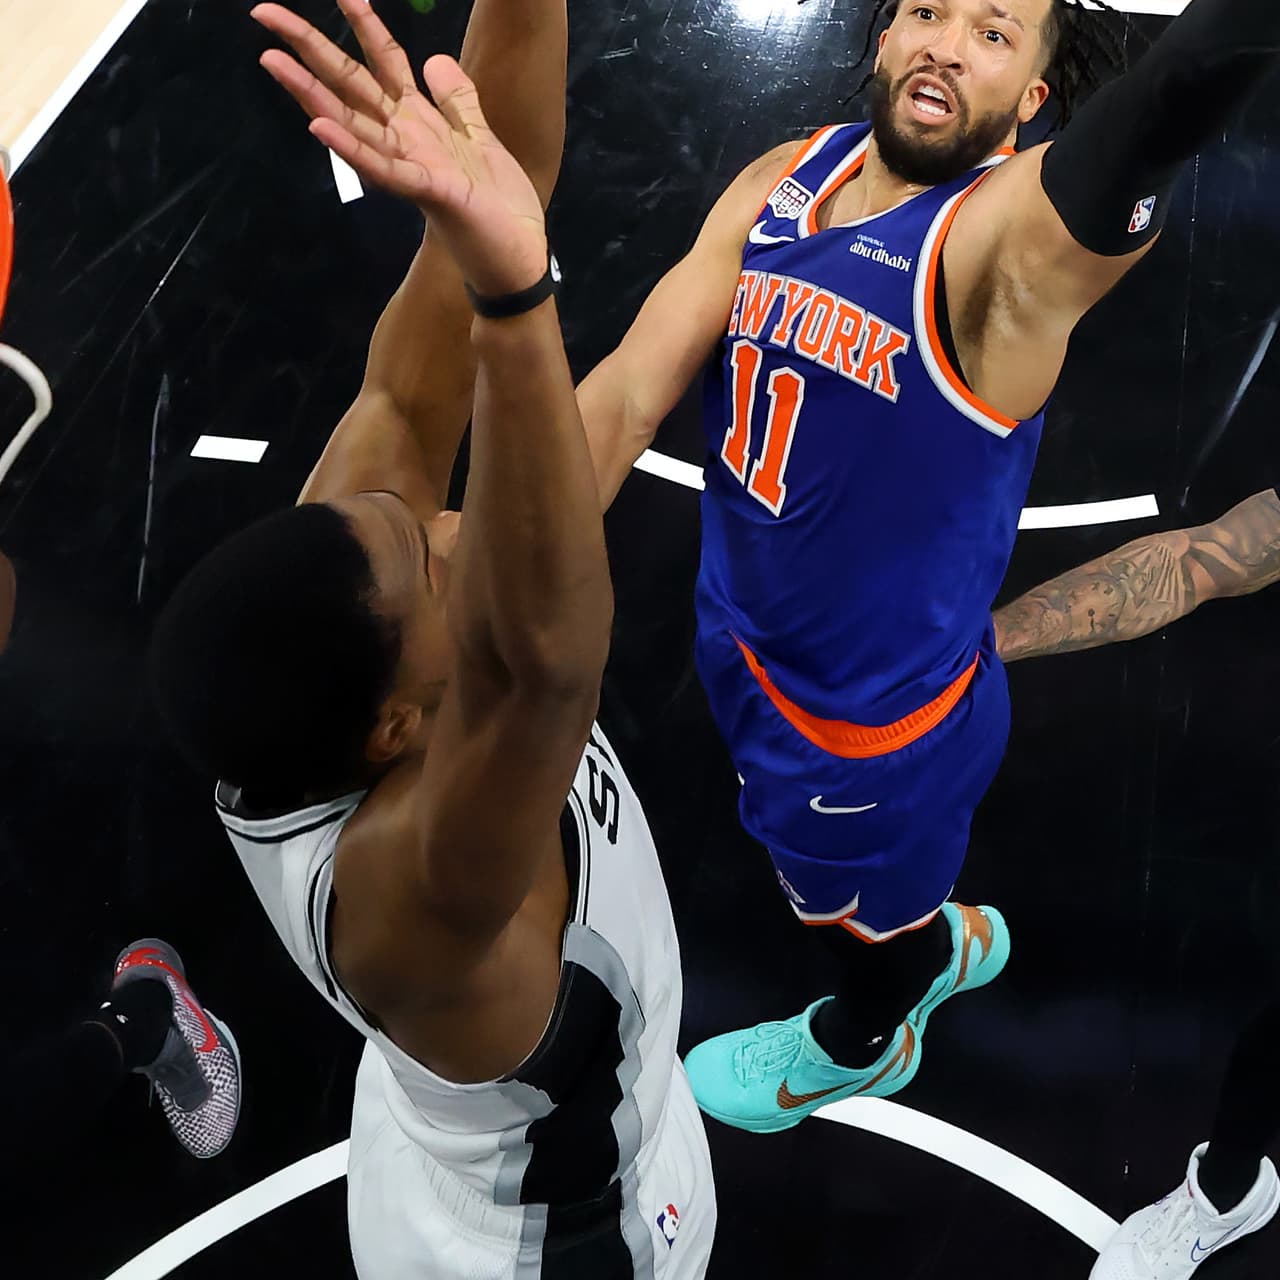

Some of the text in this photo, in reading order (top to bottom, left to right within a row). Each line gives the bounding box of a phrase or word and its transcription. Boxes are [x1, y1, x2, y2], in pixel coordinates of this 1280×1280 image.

[782, 182, 808, 204] USA
[849, 242, 913, 272] abu dhabi
[728, 270, 911, 403] EW YORK
[721, 339, 805, 517] 11
